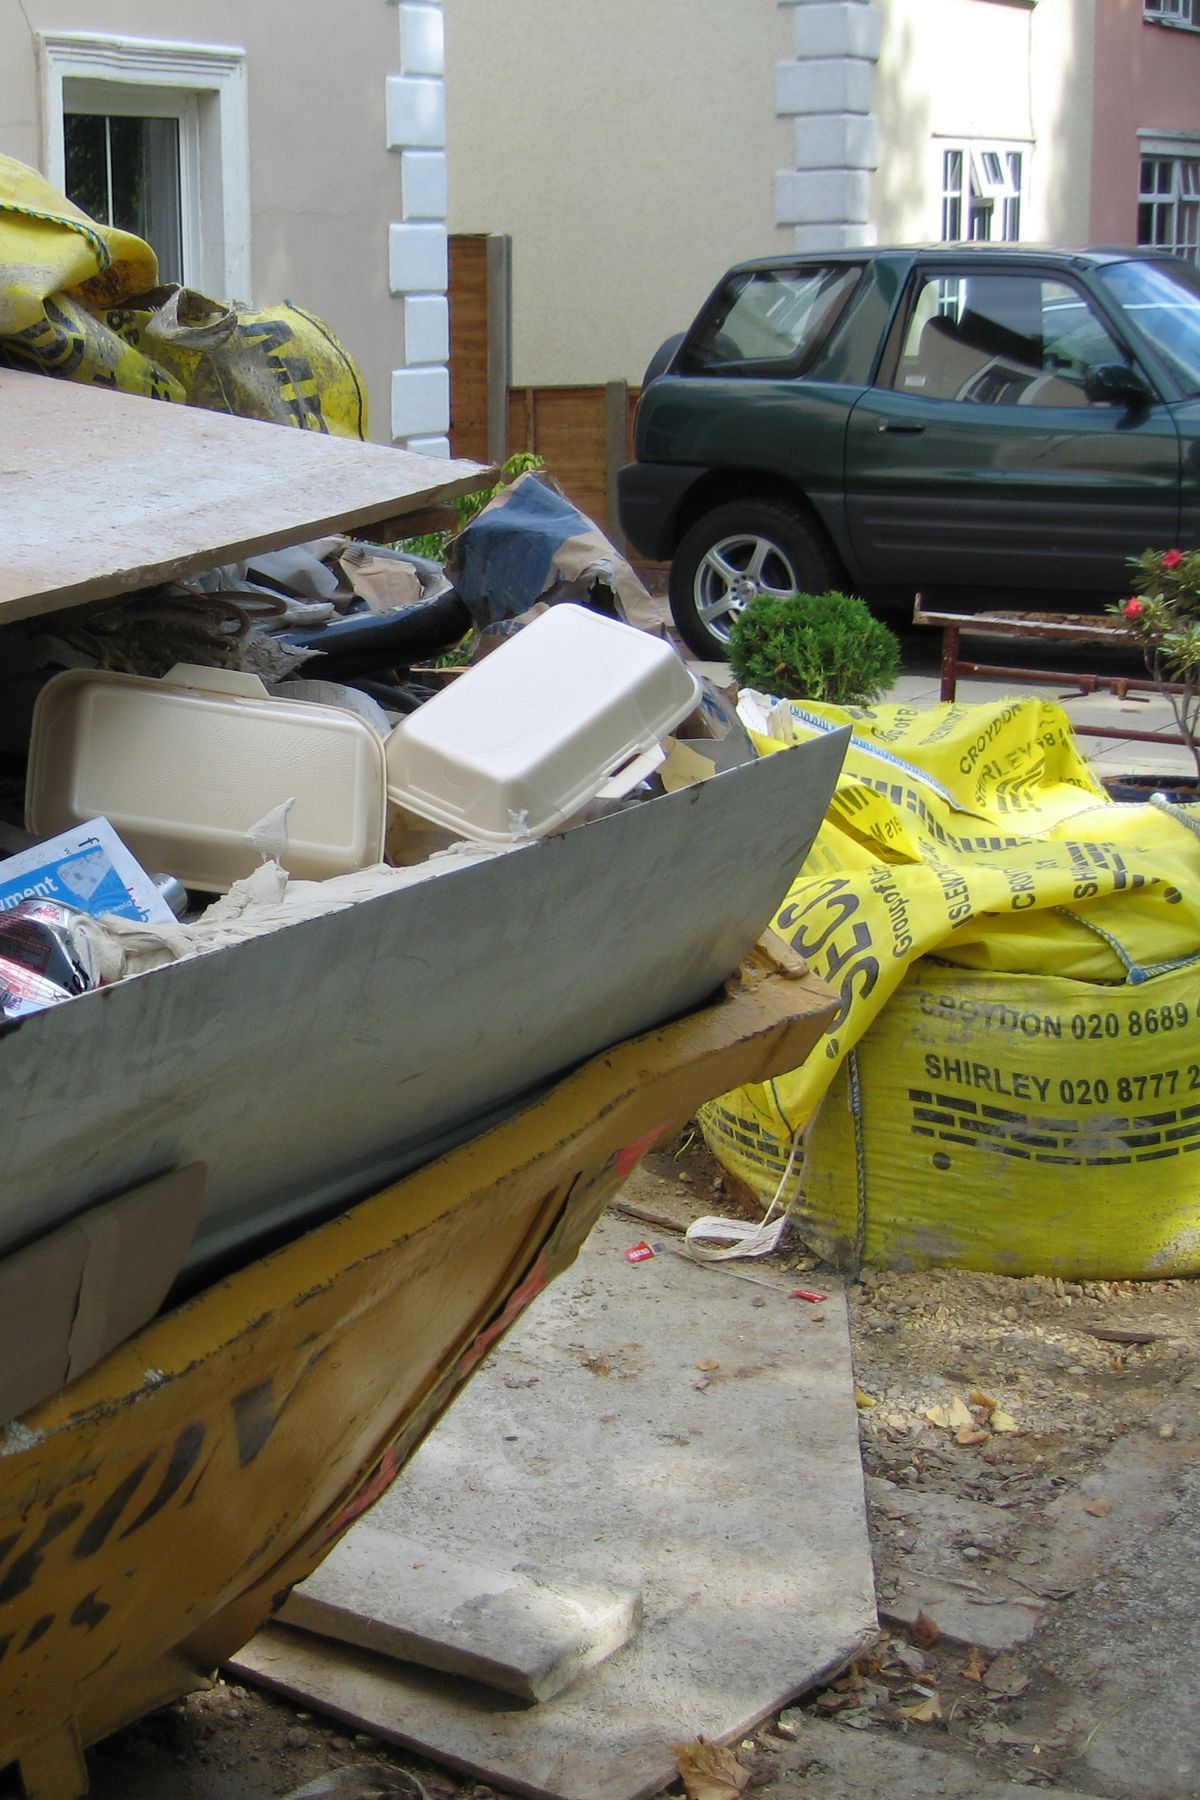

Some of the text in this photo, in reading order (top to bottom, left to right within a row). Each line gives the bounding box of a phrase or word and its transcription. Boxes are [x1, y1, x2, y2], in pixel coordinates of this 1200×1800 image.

[777, 877, 880, 1035] SECC
[919, 991, 1062, 1039] CROYDON
[1071, 1013, 1120, 1040] 020
[1128, 1002, 1188, 1037] 8689
[924, 1053, 1051, 1103] SHIRLEY
[1059, 1078, 1109, 1105] 020
[1116, 1069, 1180, 1103] 8777
